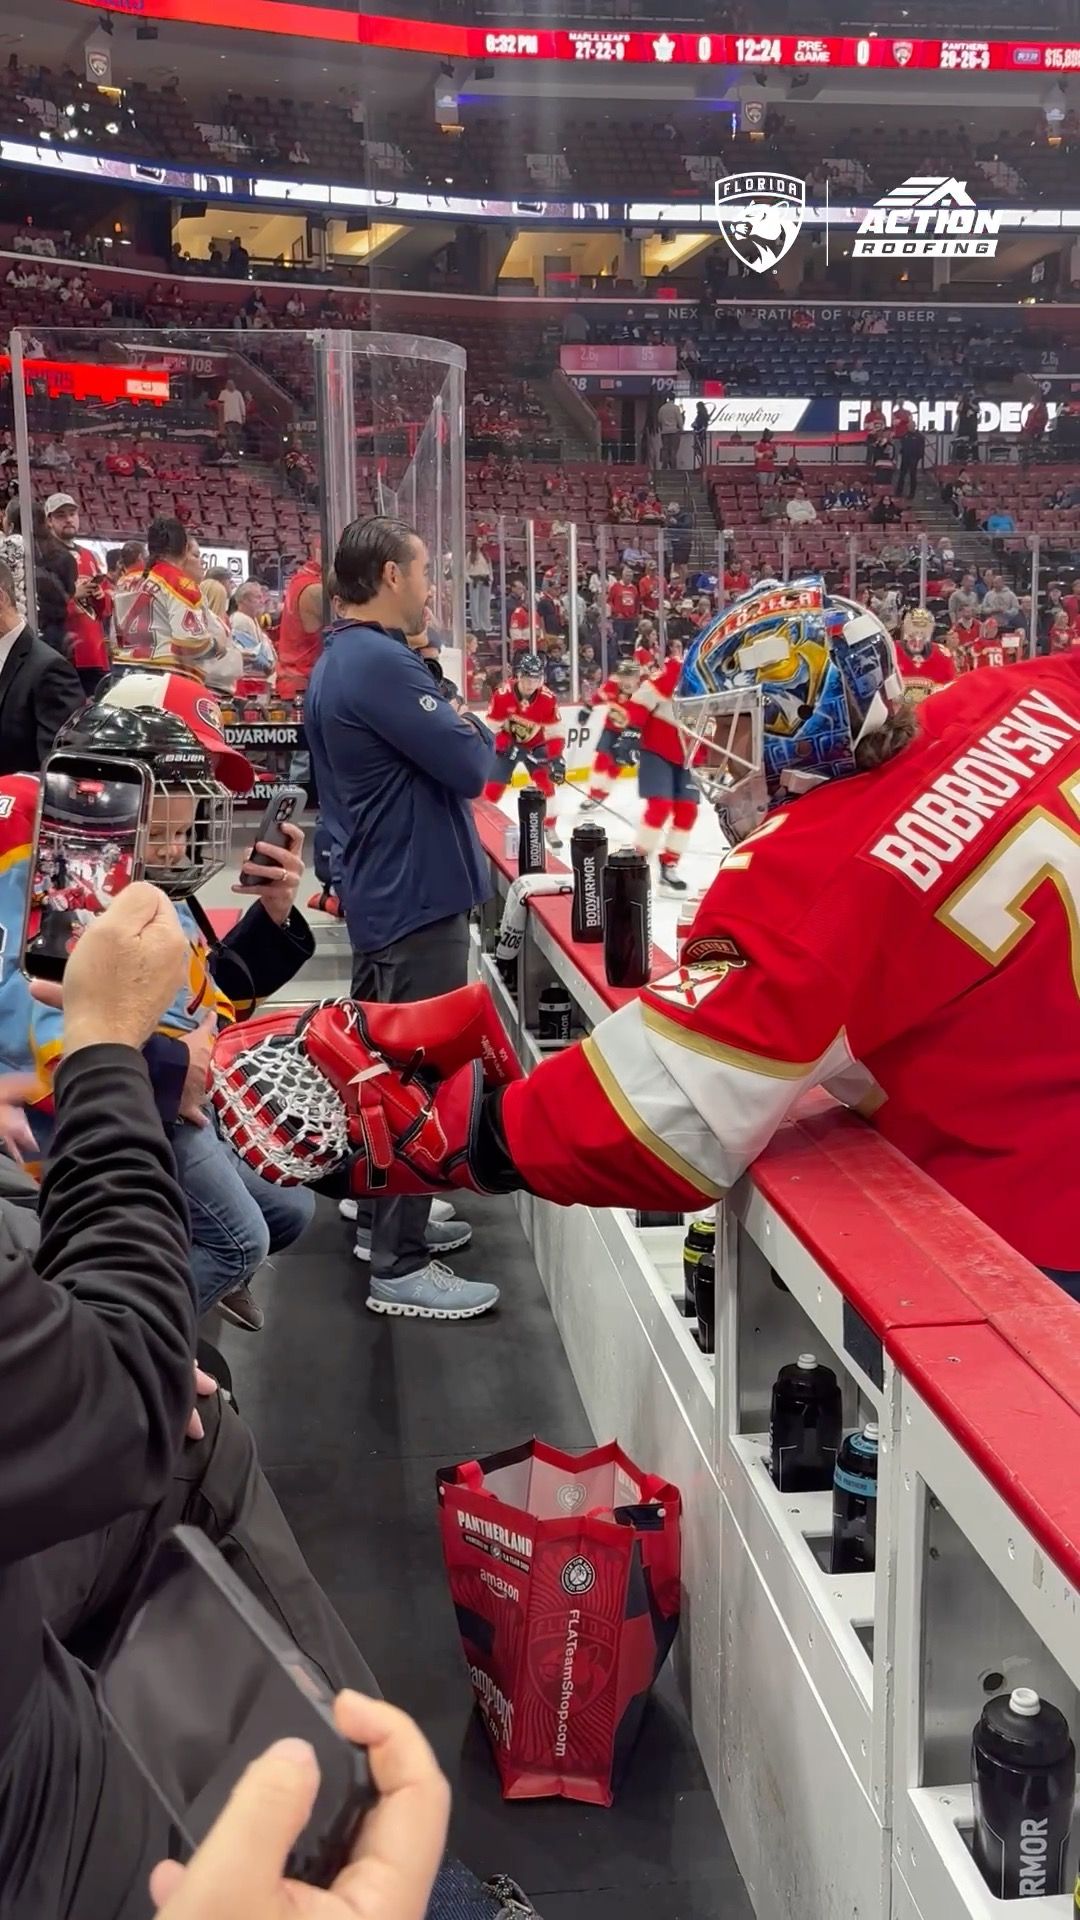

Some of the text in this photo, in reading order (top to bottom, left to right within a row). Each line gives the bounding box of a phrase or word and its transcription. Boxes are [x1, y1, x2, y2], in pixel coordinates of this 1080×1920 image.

[518, 35, 538, 54] PM
[698, 36, 711, 61] 0
[735, 38, 781, 63] 12:24
[794, 51, 830, 62] GAME
[797, 41, 827, 51] PRE-
[857, 40, 870, 66] 0
[668, 308, 699, 319] NEX
[821, 309, 842, 320] OF
[897, 311, 935, 322] BEER
[704, 402, 782, 427] Yuengling
[225, 728, 298, 744] DYARMOR
[165, 753, 205, 763] BAUER
[870, 688, 1080, 893] BOBROVSKY
[529, 812, 539, 867] BODYARMOR
[583, 856, 597, 928] BODYARMOR
[457, 1509, 534, 1558] PANTHERLAND
[480, 1568, 519, 1602] amazon
[555, 1609, 580, 1757] FLATeamShop.com
